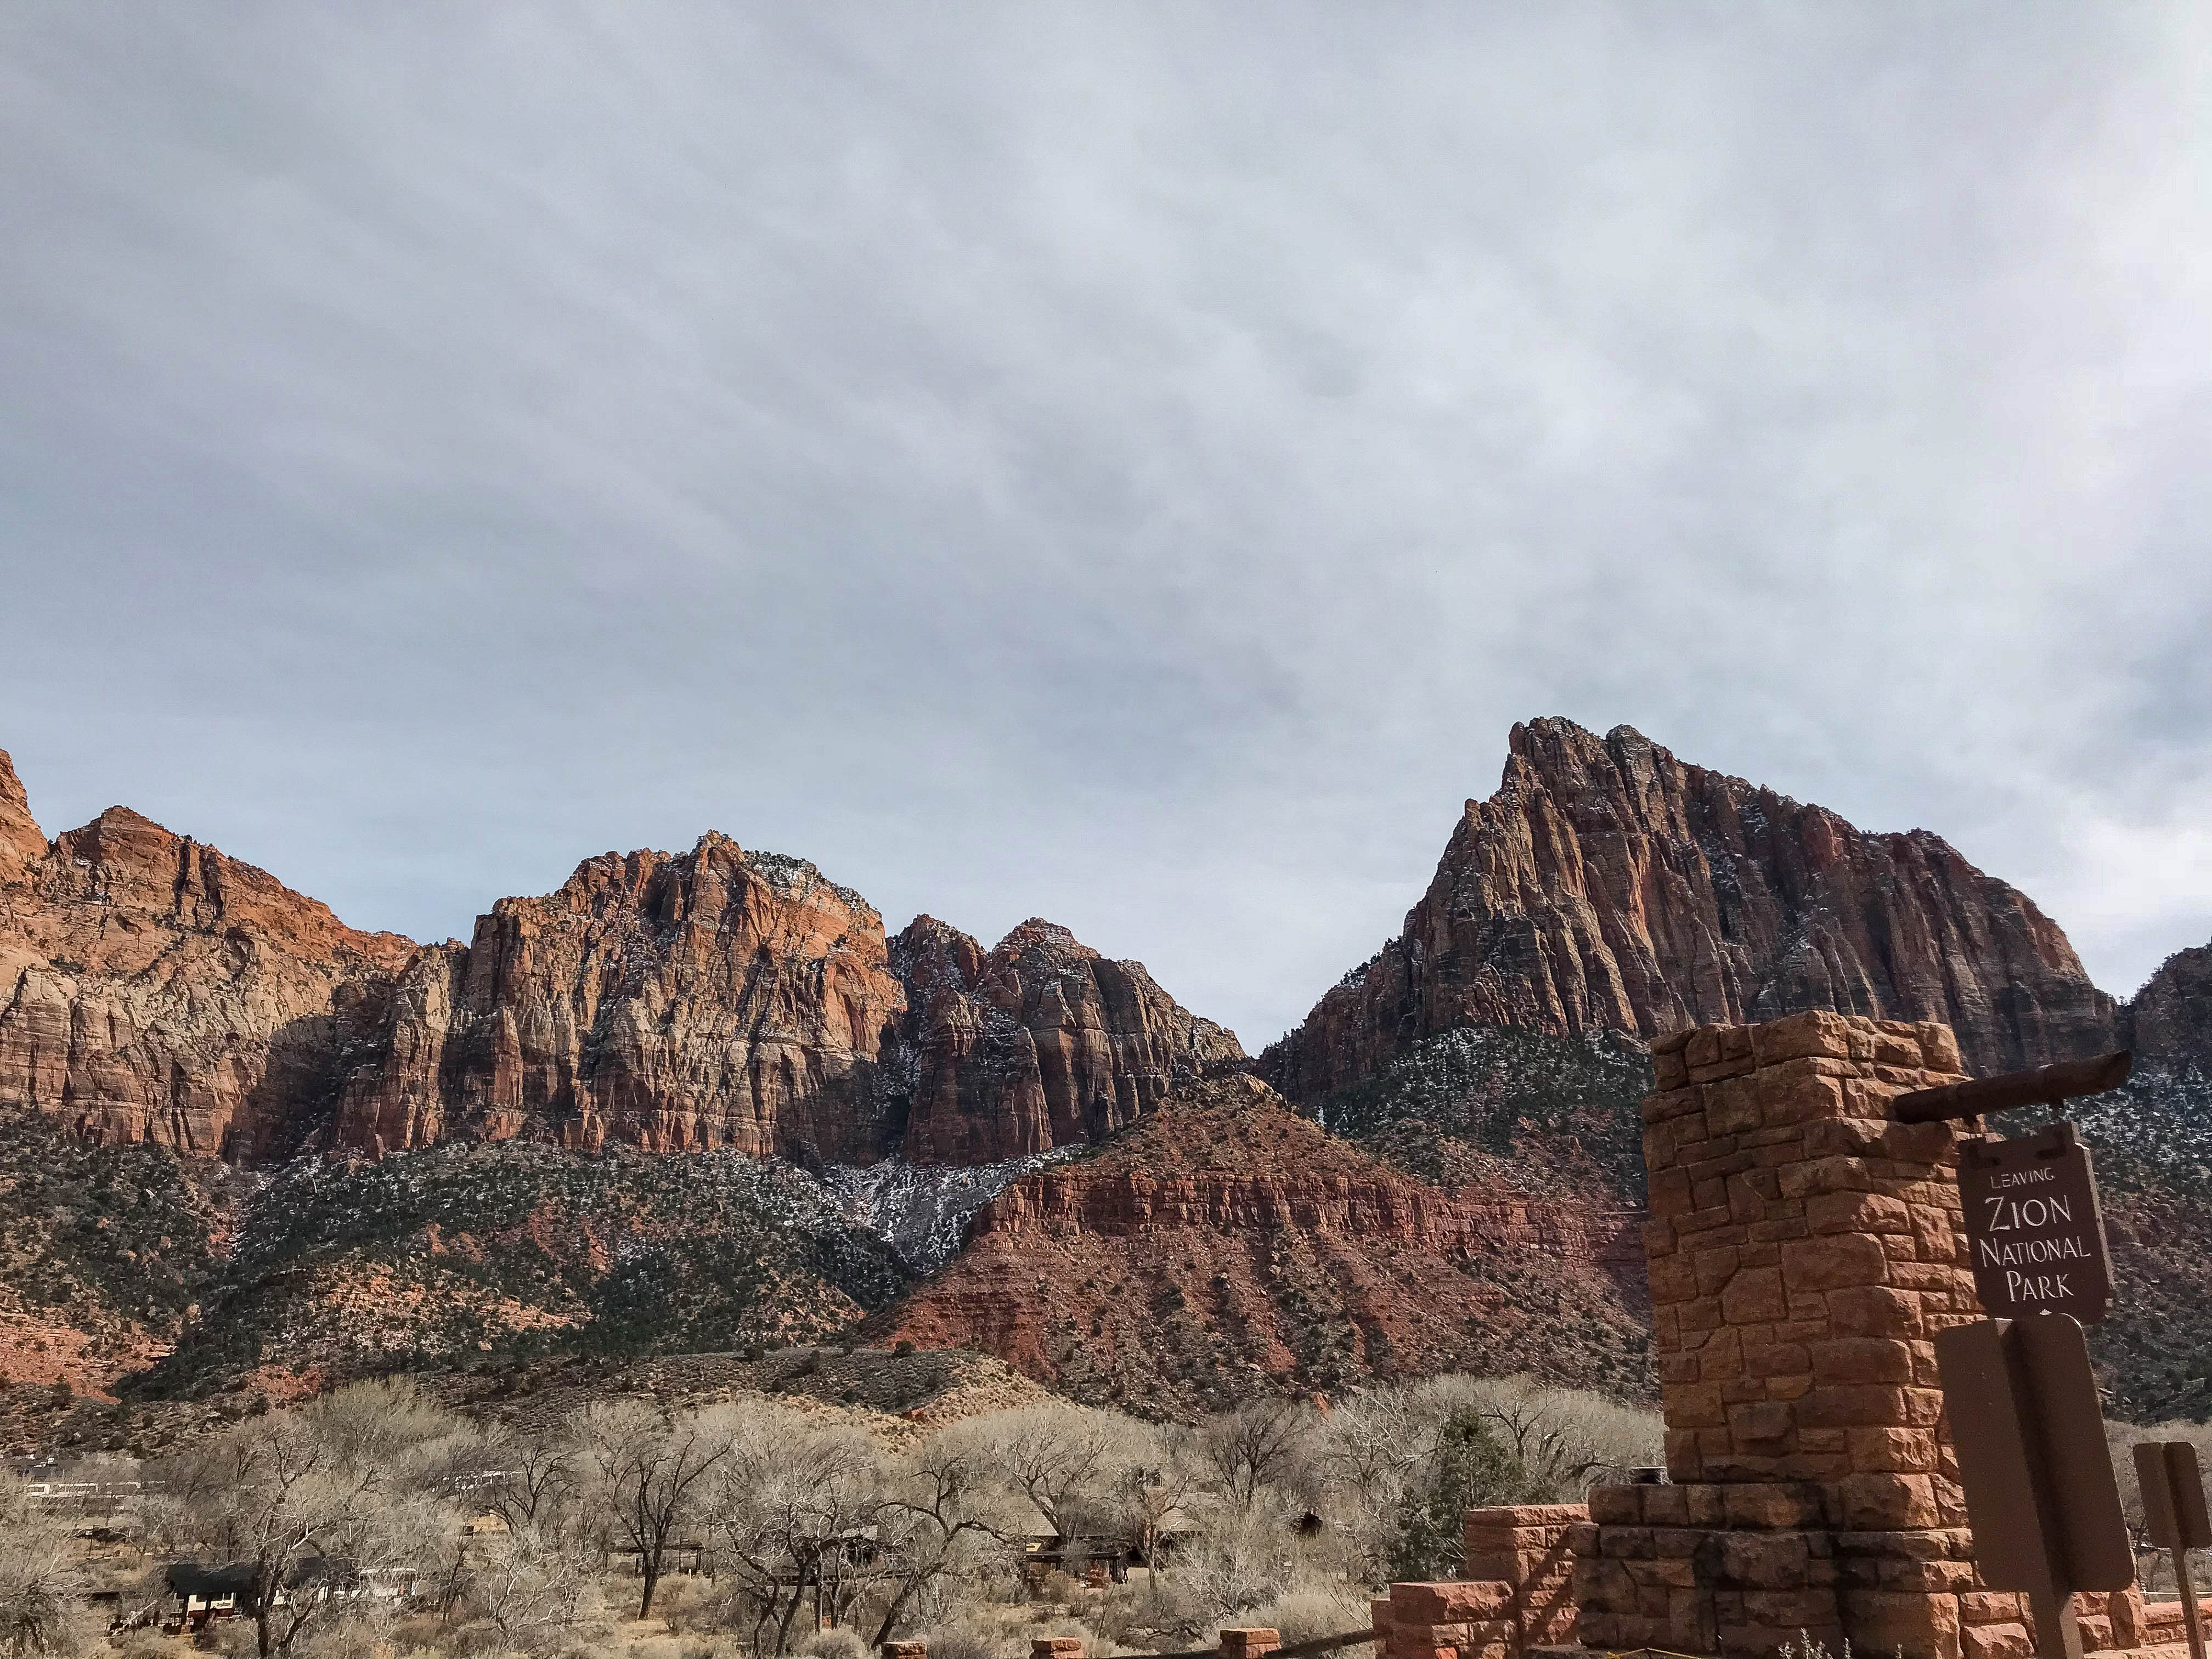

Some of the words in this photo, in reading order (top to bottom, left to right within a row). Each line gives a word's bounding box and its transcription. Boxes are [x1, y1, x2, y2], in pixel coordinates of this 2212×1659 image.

[1990, 1167, 2055, 1189] LEAVING
[1985, 1194, 2072, 1232] ZION
[1979, 1235, 2092, 1268] NATIONAL
[2006, 1270, 2075, 1302] PARK
